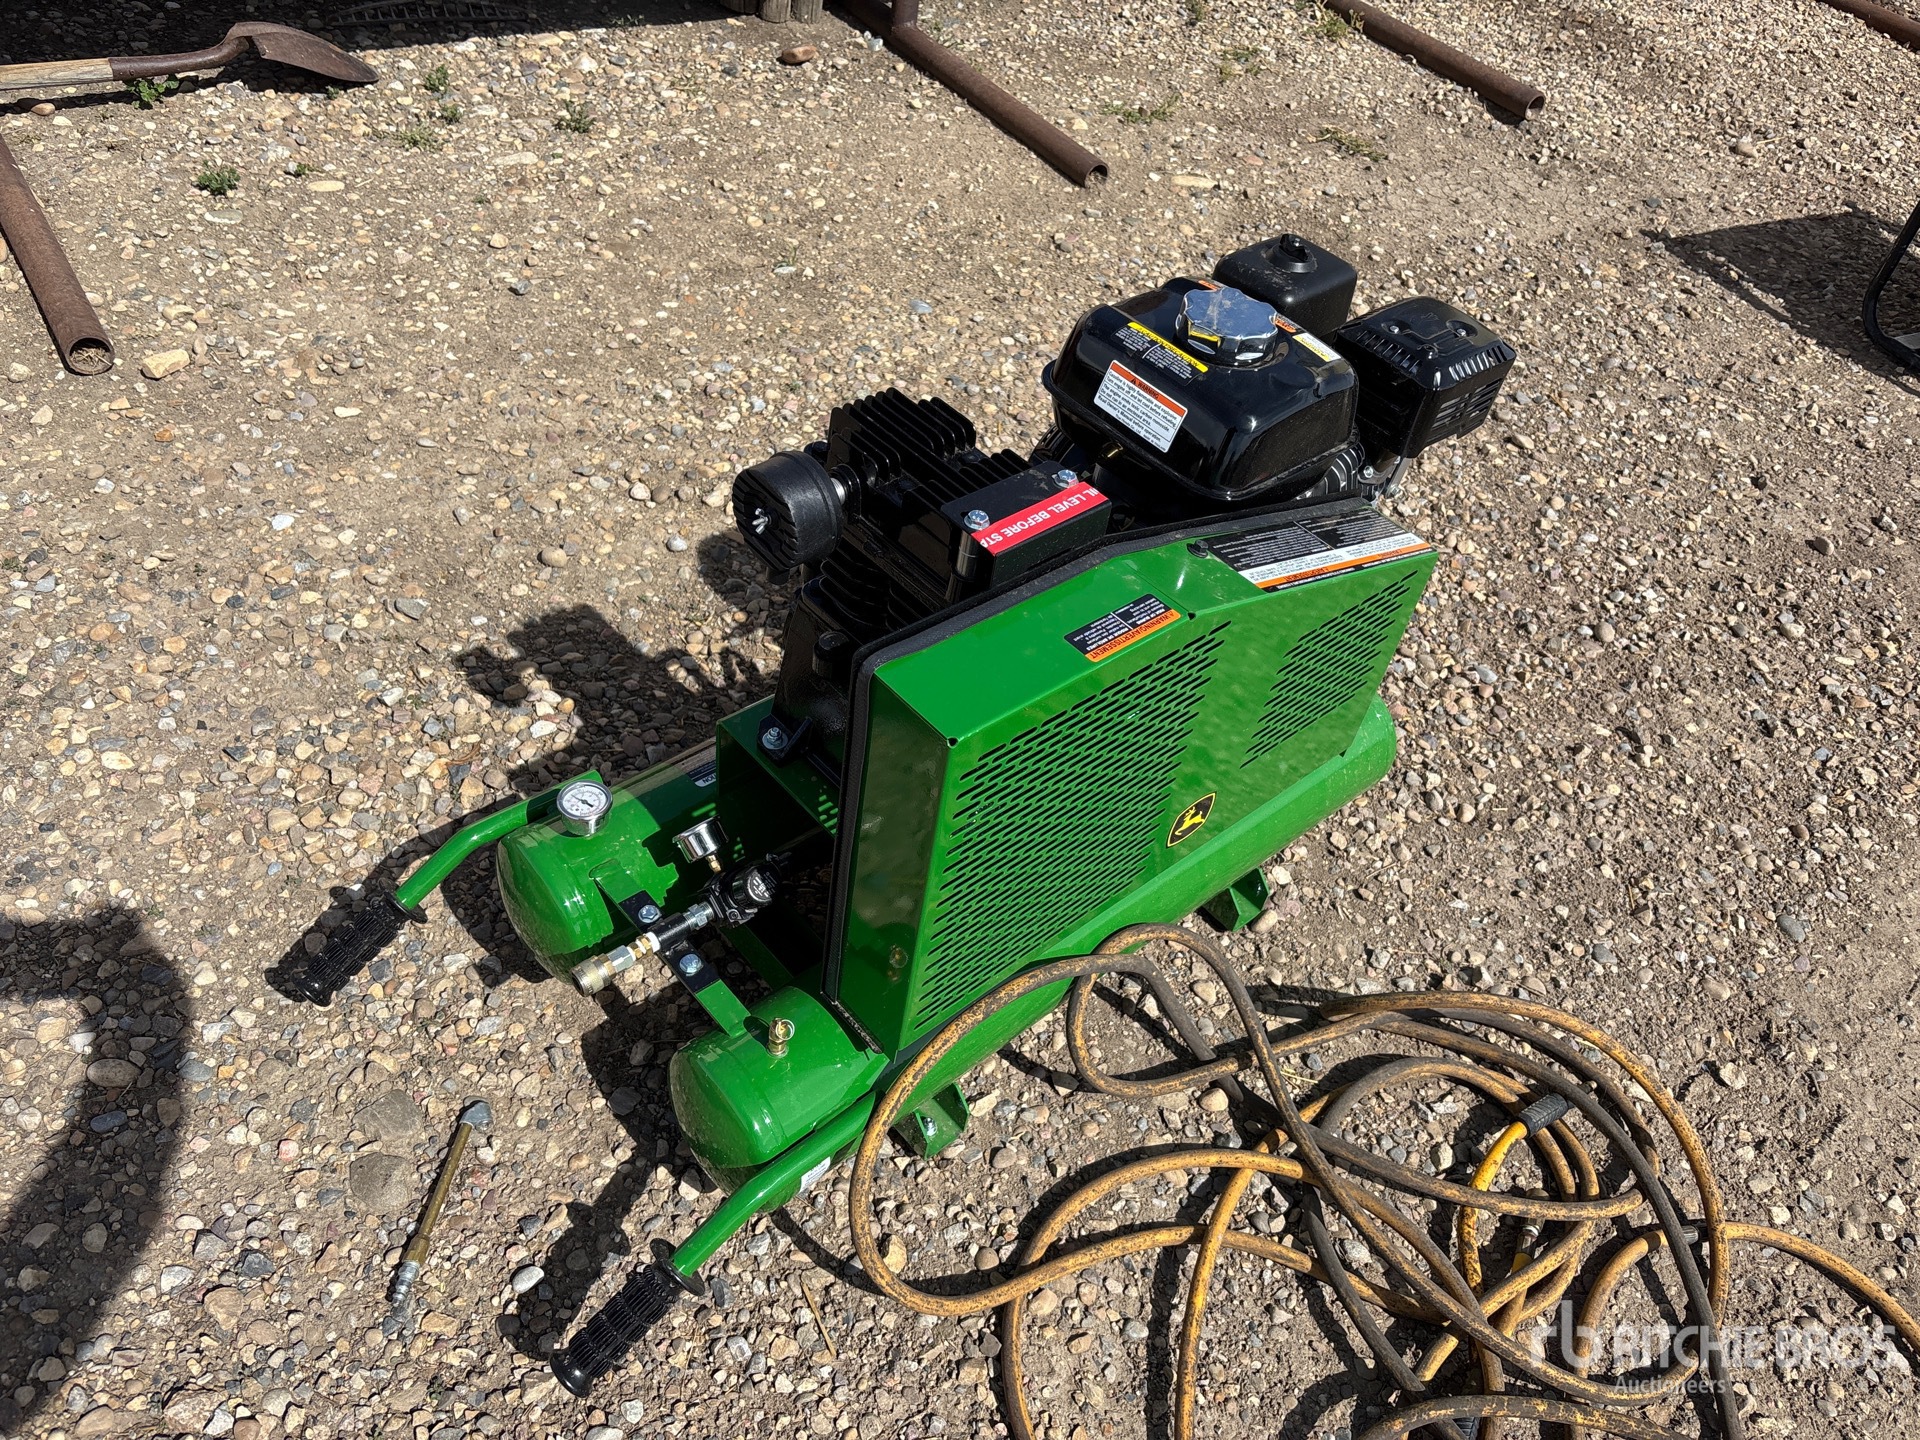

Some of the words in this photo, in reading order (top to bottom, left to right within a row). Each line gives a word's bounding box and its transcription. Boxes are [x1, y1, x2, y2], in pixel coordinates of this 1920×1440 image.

[1106, 376, 1114, 384] Turn
[1113, 381, 1125, 392] engine
[1141, 400, 1150, 408] cool
[1149, 405, 1161, 416] before
[1108, 371, 1122, 383] Gasoline
[1125, 383, 1136, 393] highly
[1136, 390, 1154, 404] flammable
[1109, 387, 1121, 399] engine
[1121, 395, 1131, 405] emits
[1130, 402, 1140, 411] toxic
[1139, 408, 1152, 420] carbon
[1137, 381, 1159, 399] WARNING
[1097, 395, 1107, 404] Read
[1106, 401, 1120, 413] Owner's
[1119, 410, 1133, 422] Manual
[1132, 419, 1144, 430] before
[1143, 427, 1161, 442] operation.
[1126, 406, 1142, 419] enclosed
[1142, 417, 1152, 426] area.
[1048, 493, 1086, 513] LEVEL
[1003, 510, 1051, 537] BEFORE
[1089, 614, 1170, 658] WARNING/AVERTISSEMENT
